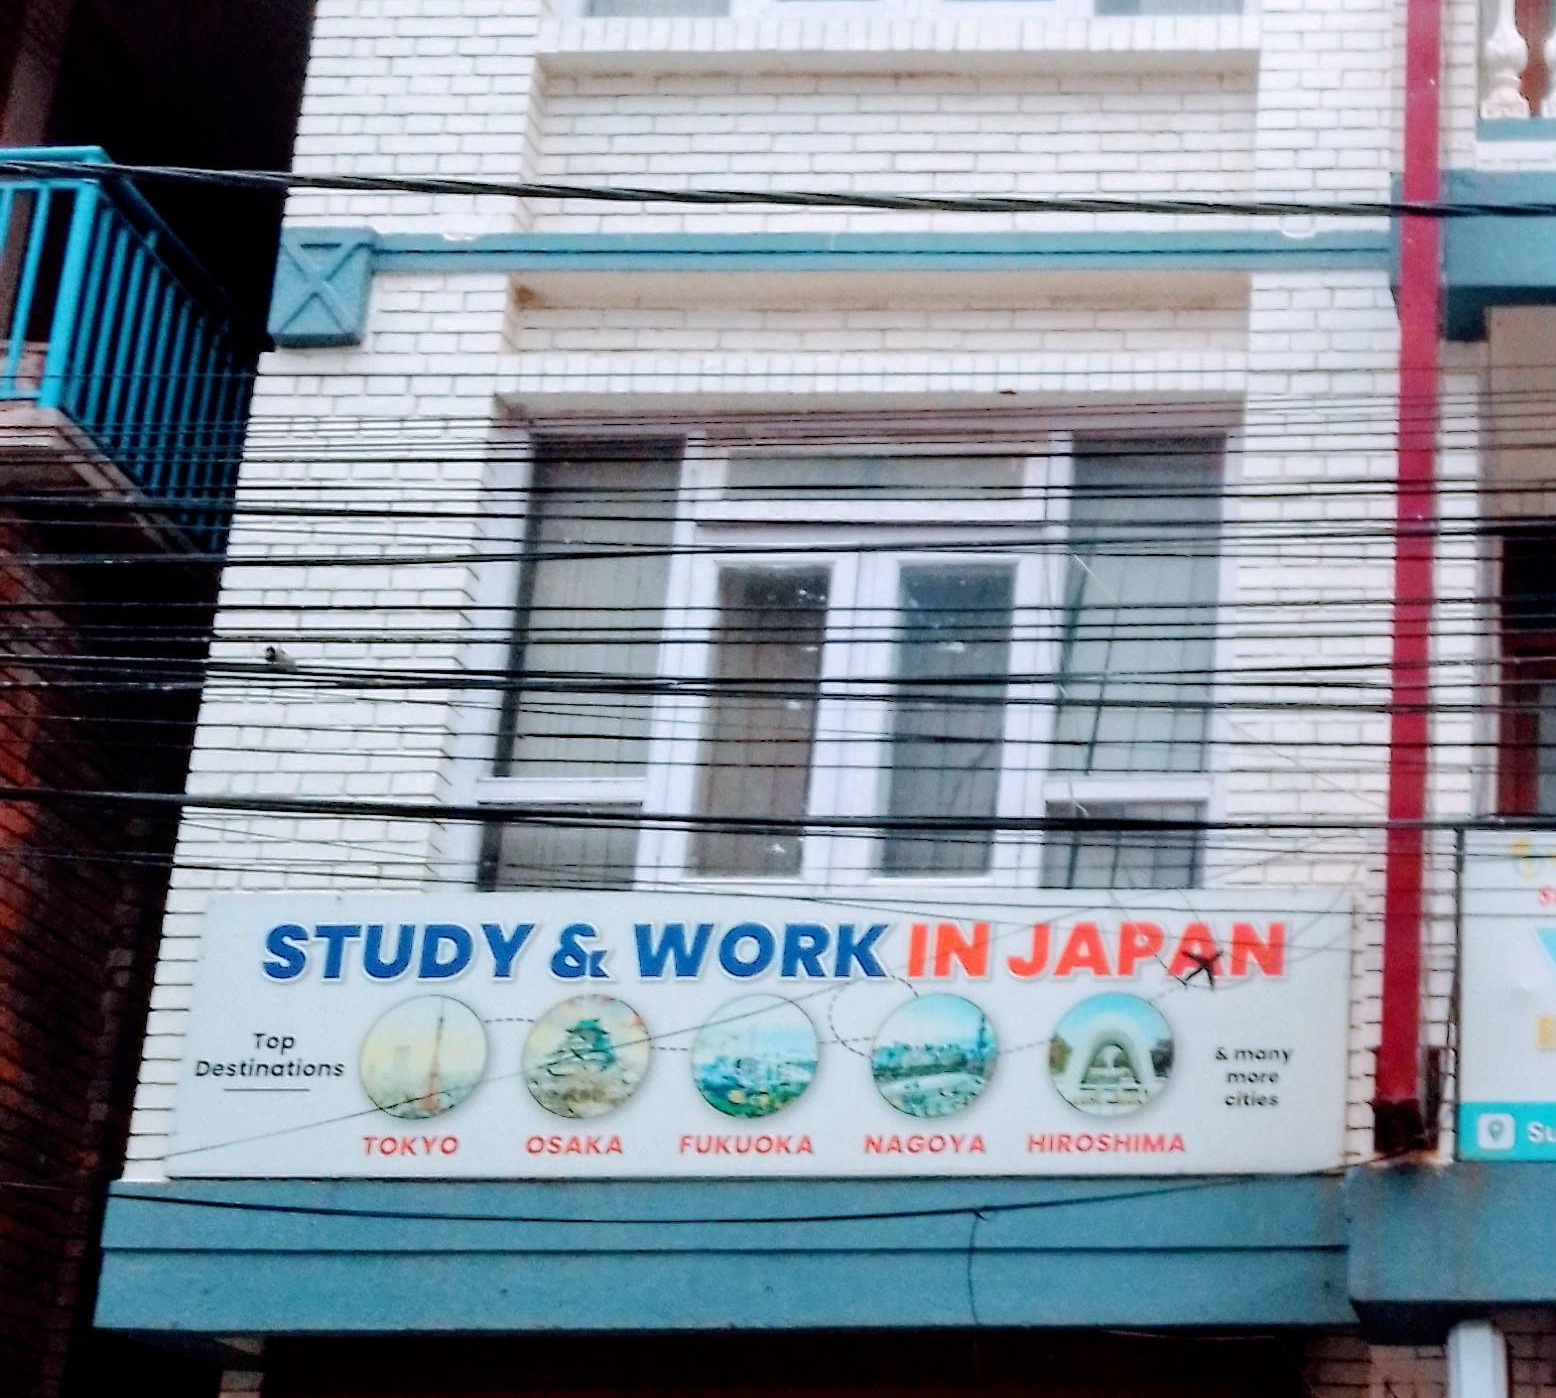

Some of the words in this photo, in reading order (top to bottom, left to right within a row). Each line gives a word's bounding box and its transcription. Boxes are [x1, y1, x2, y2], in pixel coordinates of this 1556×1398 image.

[261, 919, 537, 981] STUDY
[552, 920, 608, 981] &
[636, 920, 892, 980] WORK
[906, 919, 988, 979] IN
[1007, 919, 1287, 979] JAPAN
[252, 1030, 297, 1056] Top
[1214, 1045, 1233, 1063] &
[1237, 1048, 1290, 1069] many
[194, 1056, 346, 1082] Destinations
[1227, 1070, 1280, 1087] more
[1224, 1089, 1280, 1111] cities
[363, 1135, 460, 1158] TOKYO
[526, 1135, 624, 1158] OSAKA
[679, 1135, 816, 1158] FUKUOKA
[863, 1135, 987, 1158] NAGOYA
[1027, 1135, 1188, 1158] HIROSHIMA
